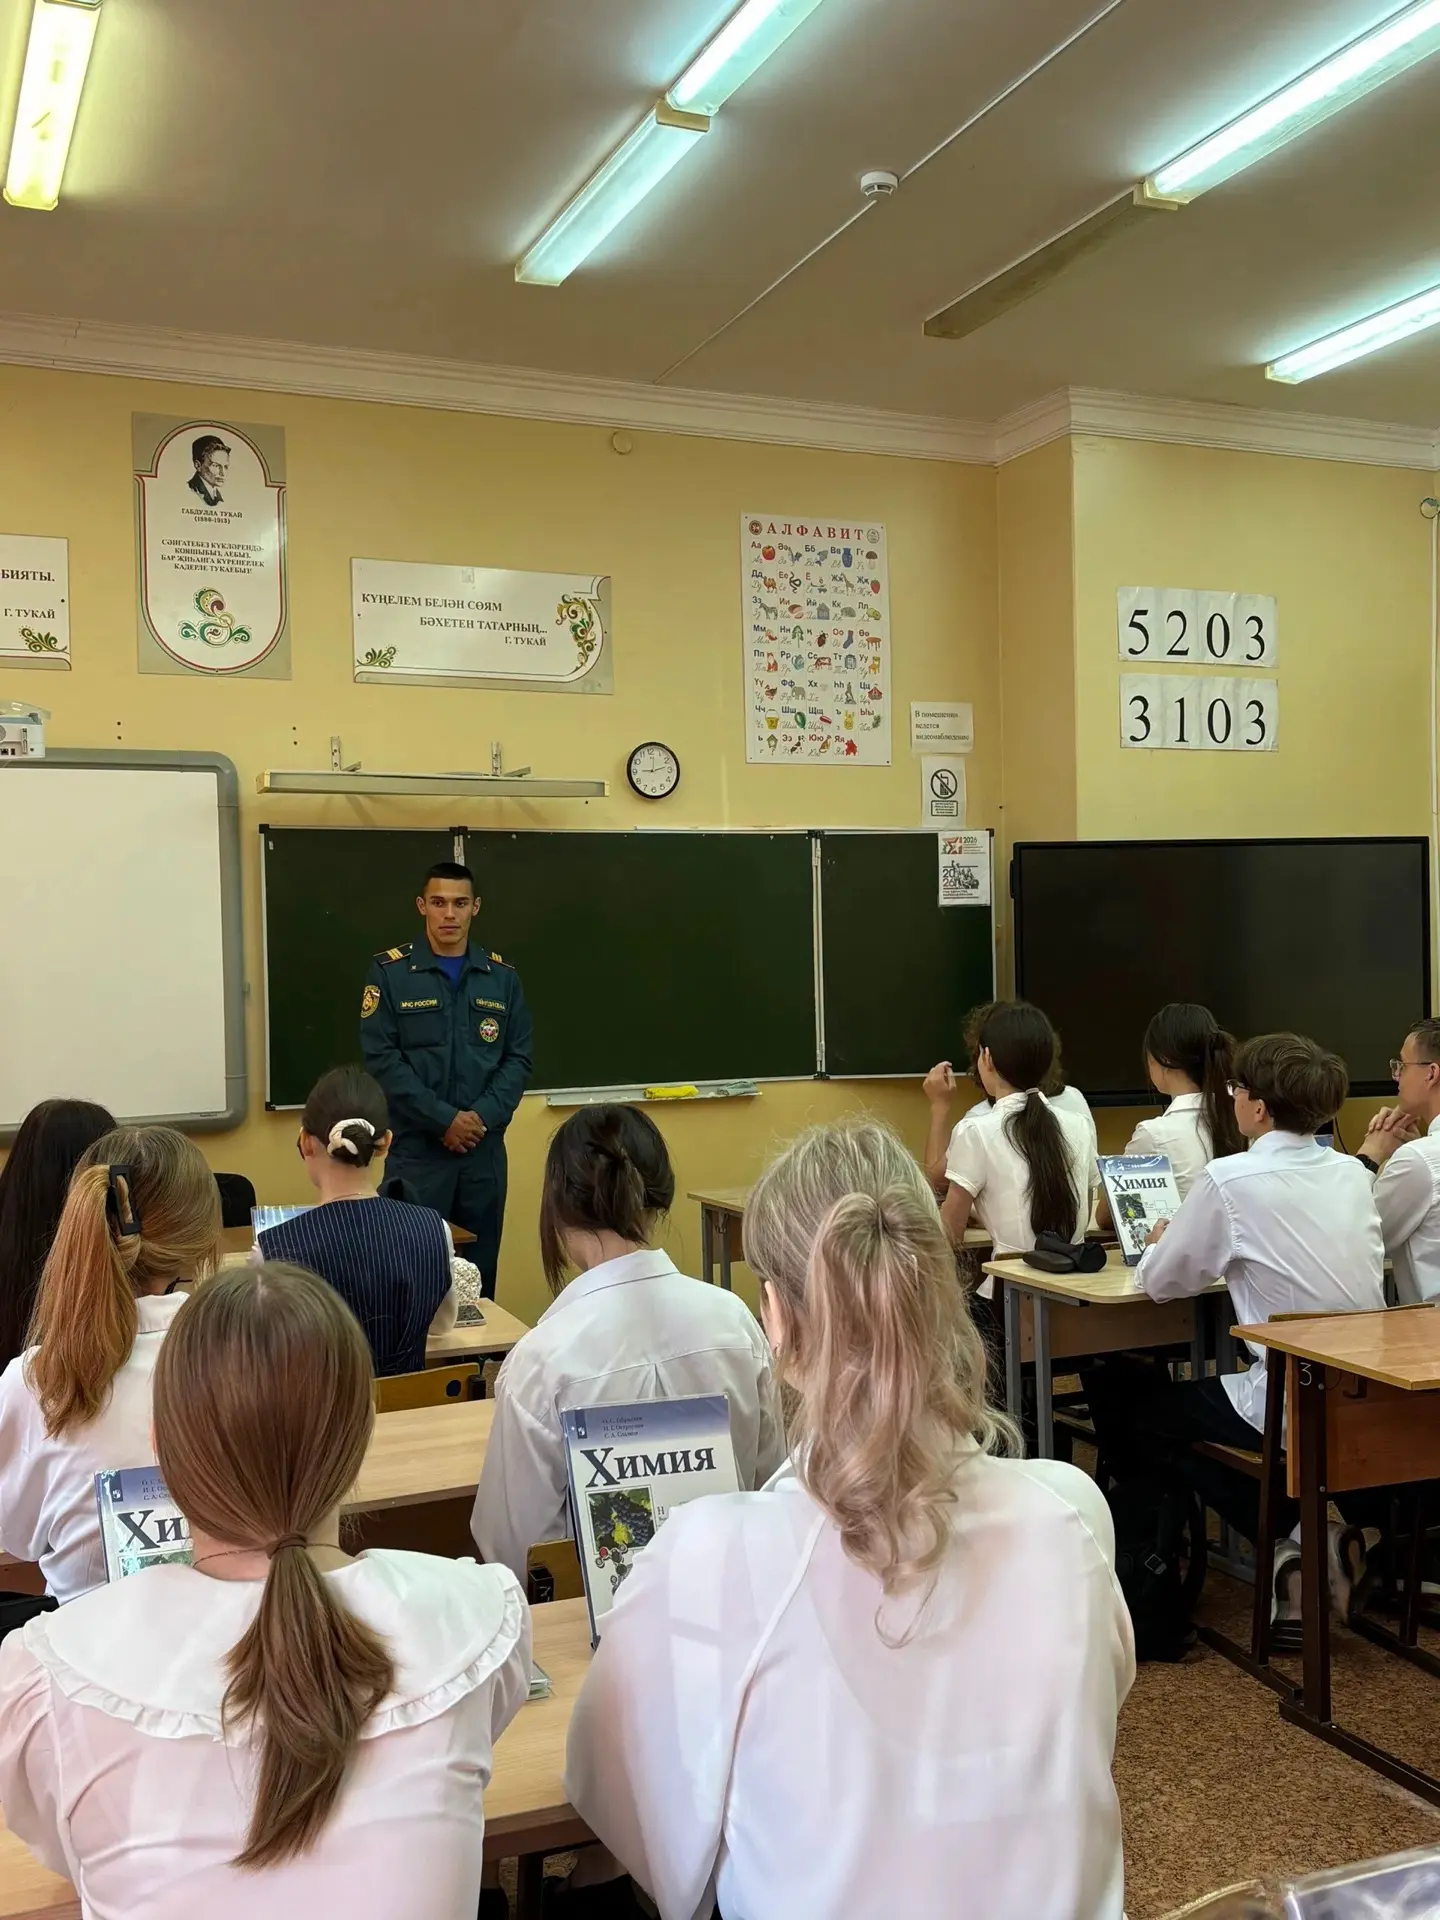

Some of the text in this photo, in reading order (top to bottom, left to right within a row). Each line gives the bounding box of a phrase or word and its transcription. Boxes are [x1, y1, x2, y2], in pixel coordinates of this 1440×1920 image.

[181, 508, 218, 516] ГАБДУЛЛА
[766, 522, 863, 540] АЛФАВИТ
[804, 544, 816, 552] Бб
[361, 592, 502, 611] КҮҢЕЛЕМ БЕЛӘН СӨЯМ
[4, 608, 56, 619] Г. ТУКАЙ
[420, 616, 474, 629] БӘХЕТЕН
[505, 636, 547, 646] Г. ТУКАЙ
[1128, 609, 1265, 660] 5203
[780, 650, 791, 660] Рр
[780, 679, 796, 688] Фф
[781, 706, 796, 714] Шш
[1129, 695, 1266, 745] 3103
[1108, 1175, 1168, 1192] Химия
[580, 1447, 717, 1488] Химия
[117, 1510, 191, 1553] Хи
